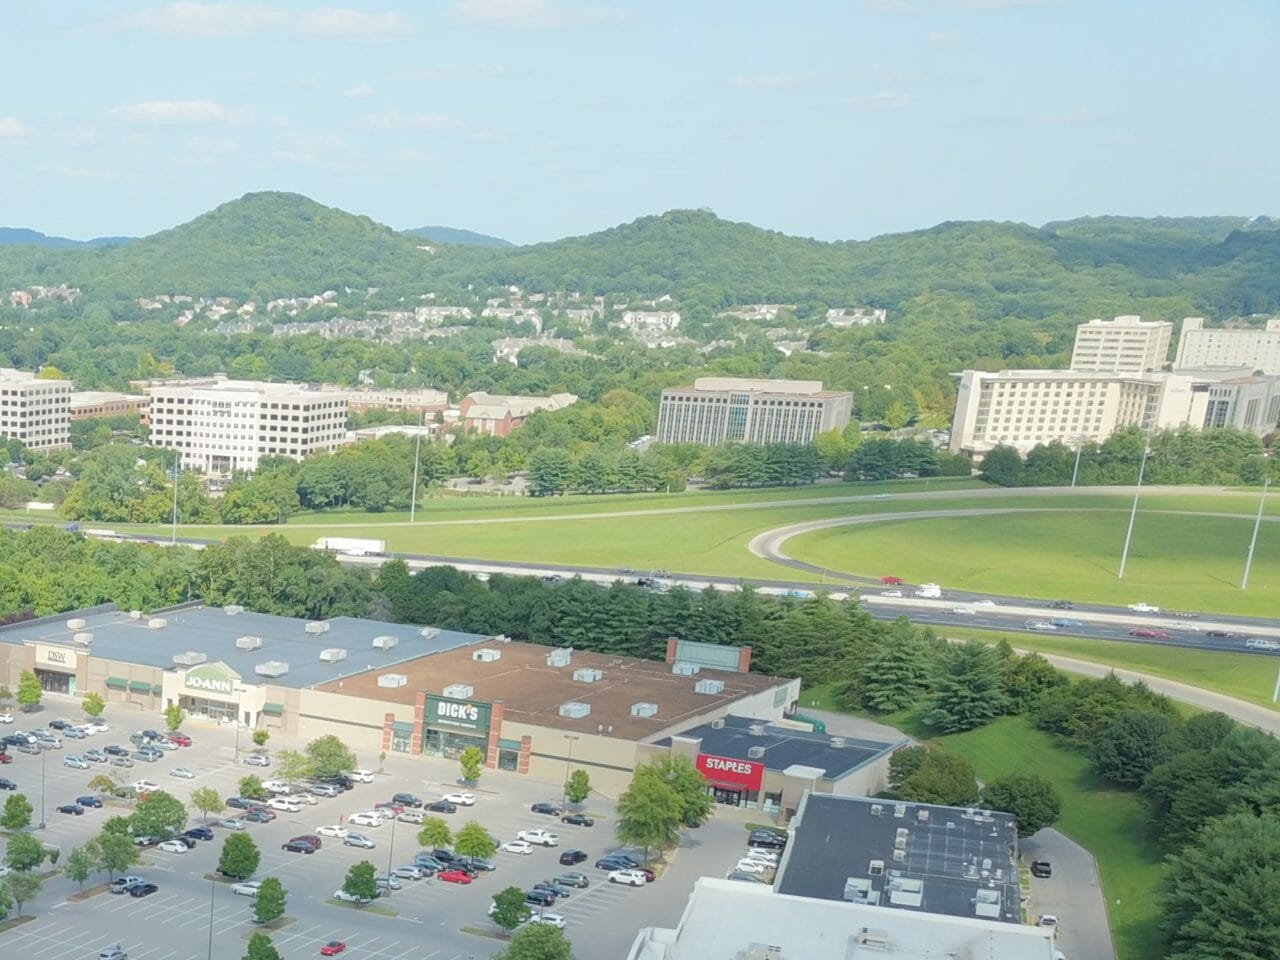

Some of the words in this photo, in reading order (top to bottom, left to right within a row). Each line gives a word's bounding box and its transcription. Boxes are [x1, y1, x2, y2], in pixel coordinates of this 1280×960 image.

[48, 650, 66, 661] DSW
[186, 676, 231, 692] JO-ANN
[437, 701, 479, 721] DICK'S
[705, 757, 752, 775] STAPLES
